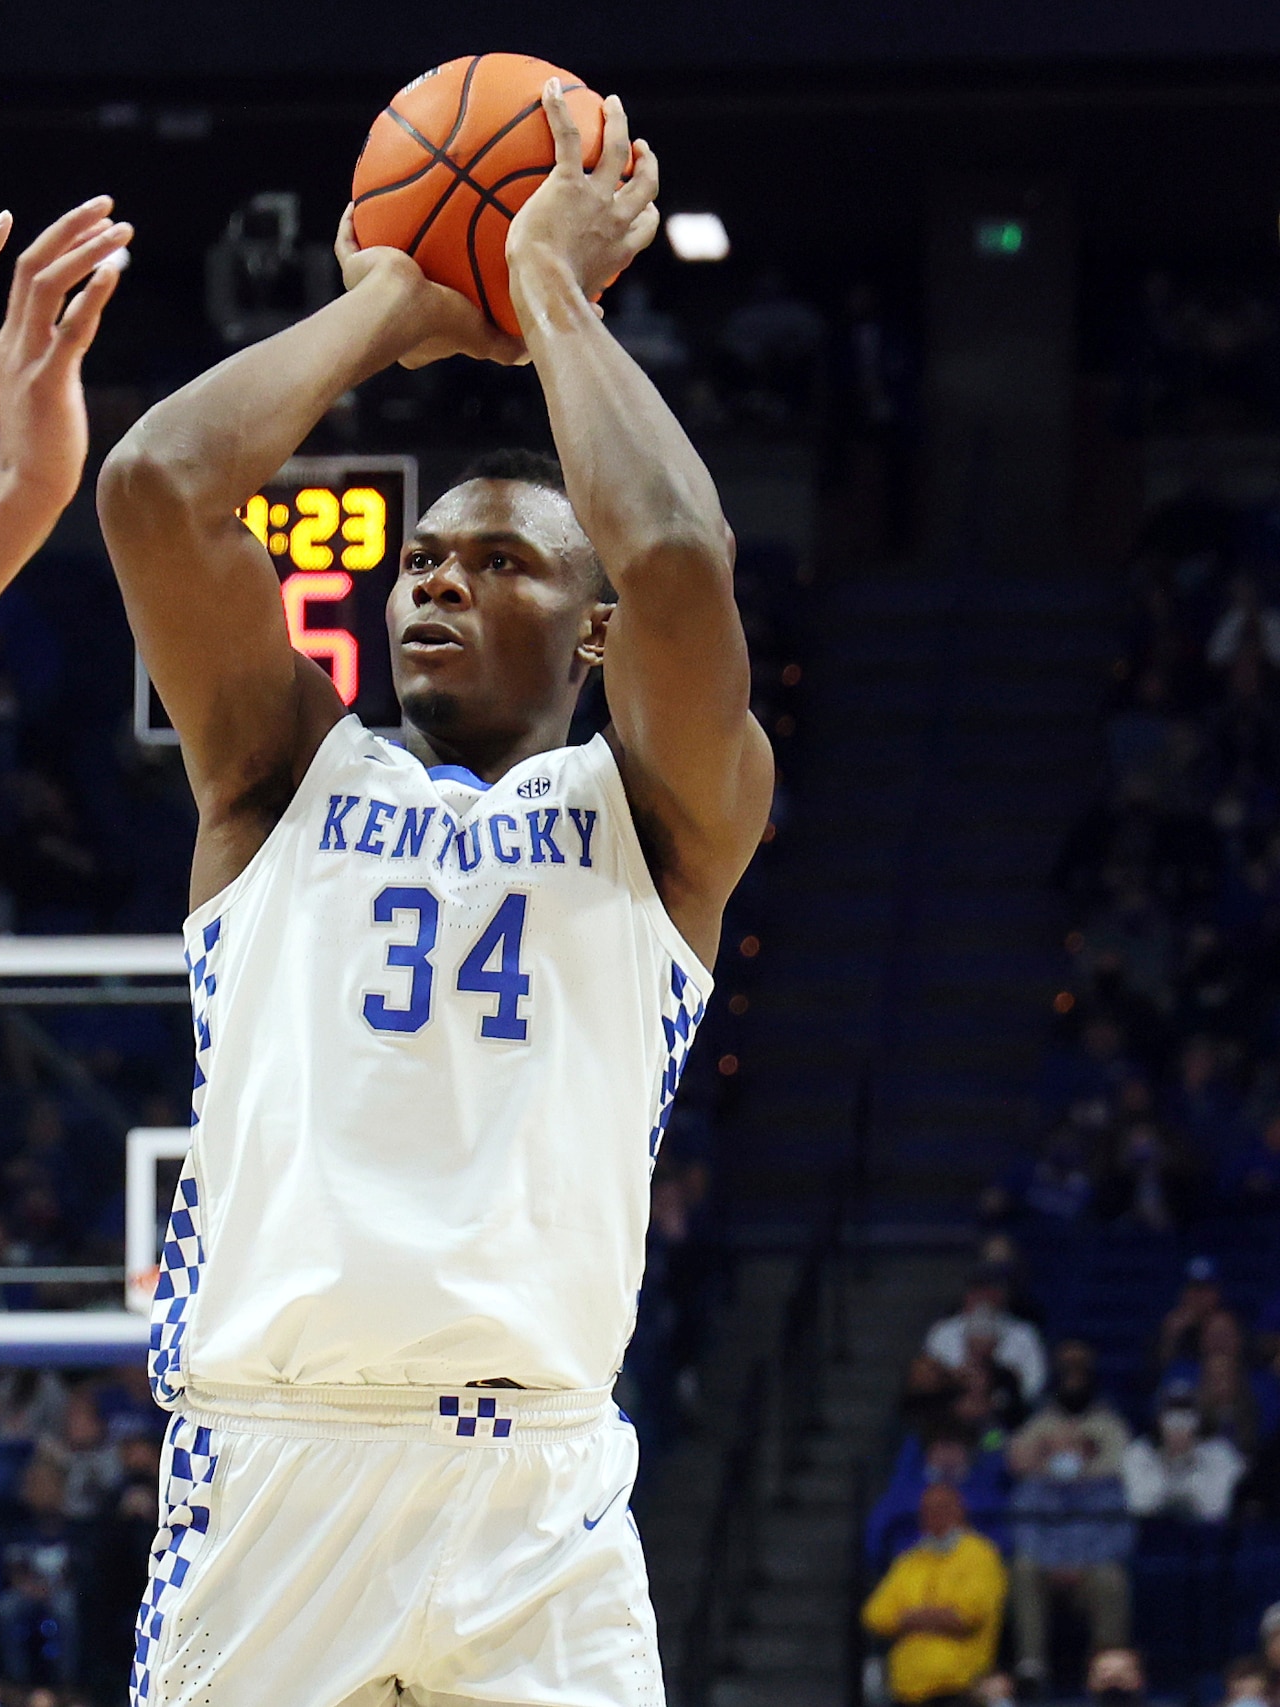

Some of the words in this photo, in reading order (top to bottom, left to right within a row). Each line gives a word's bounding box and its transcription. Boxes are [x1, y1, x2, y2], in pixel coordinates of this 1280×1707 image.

[518, 777, 550, 798] SEC
[318, 794, 597, 872] KENTUCKY
[361, 884, 531, 1043] 34
